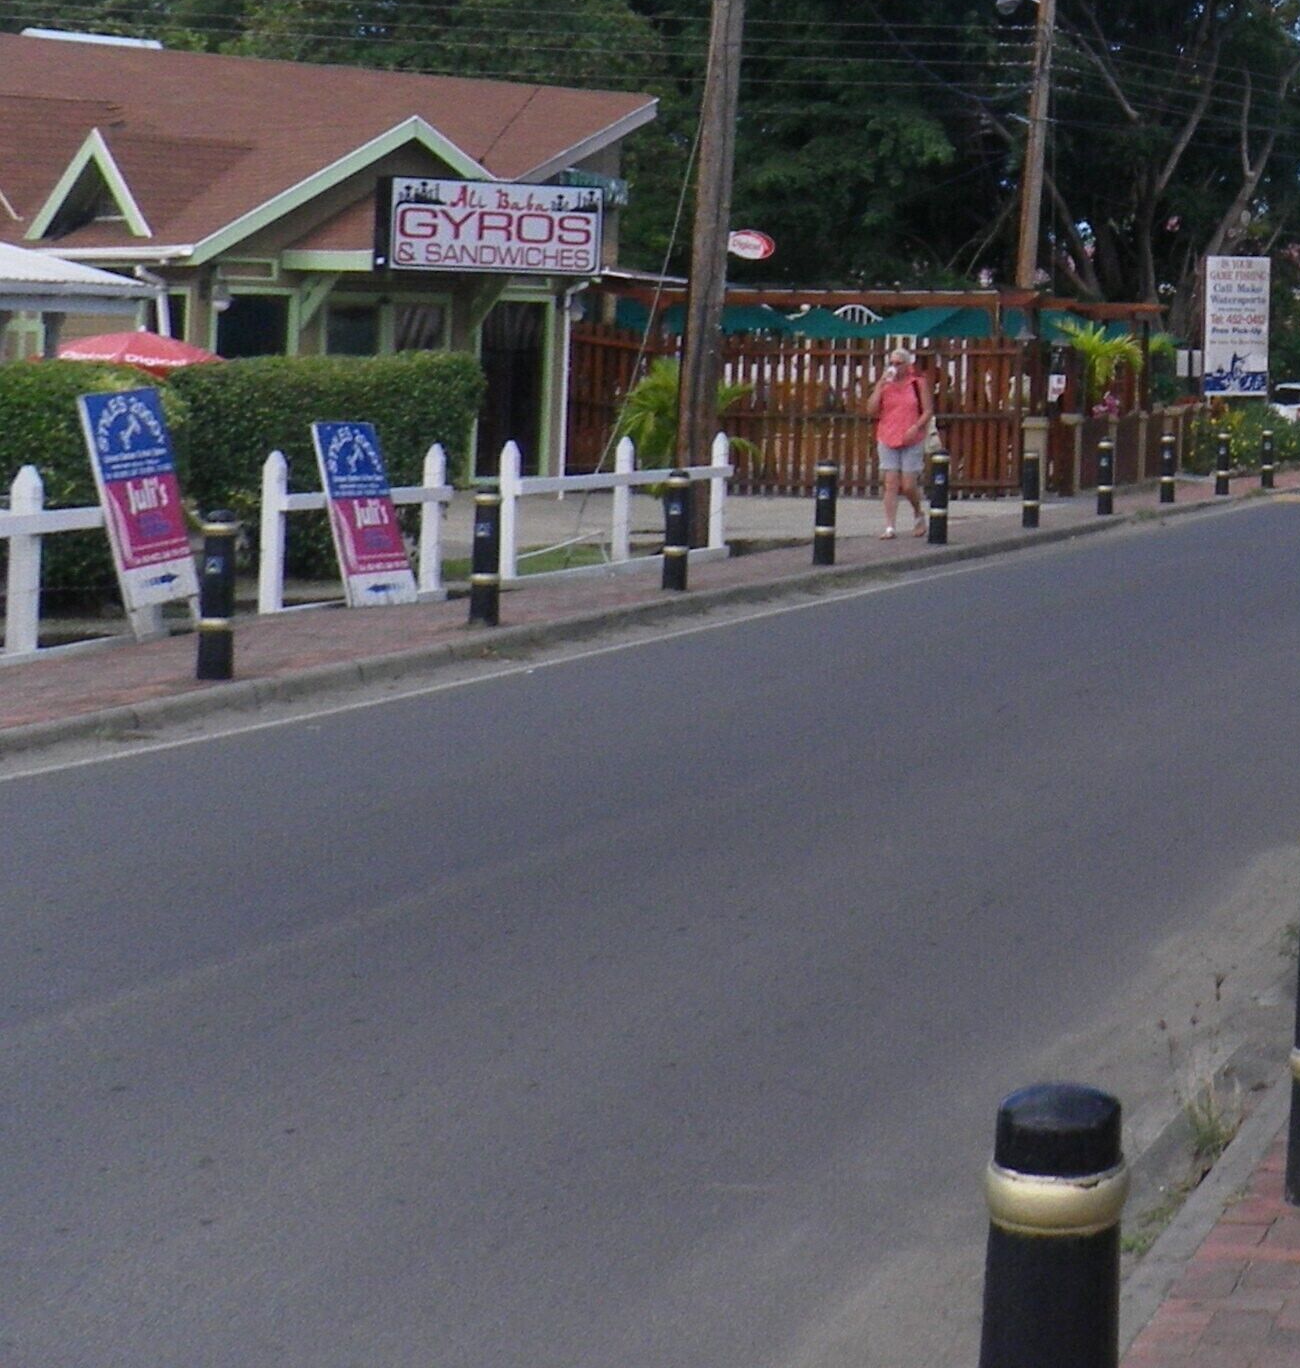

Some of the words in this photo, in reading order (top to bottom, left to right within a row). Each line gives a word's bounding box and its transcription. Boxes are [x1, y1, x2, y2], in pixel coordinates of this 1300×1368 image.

[450, 184, 490, 210] Ali
[496, 189, 550, 212] Baba
[399, 207, 592, 245] GYROS
[398, 242, 415, 262] &
[425, 243, 591, 269] SANDWICHES
